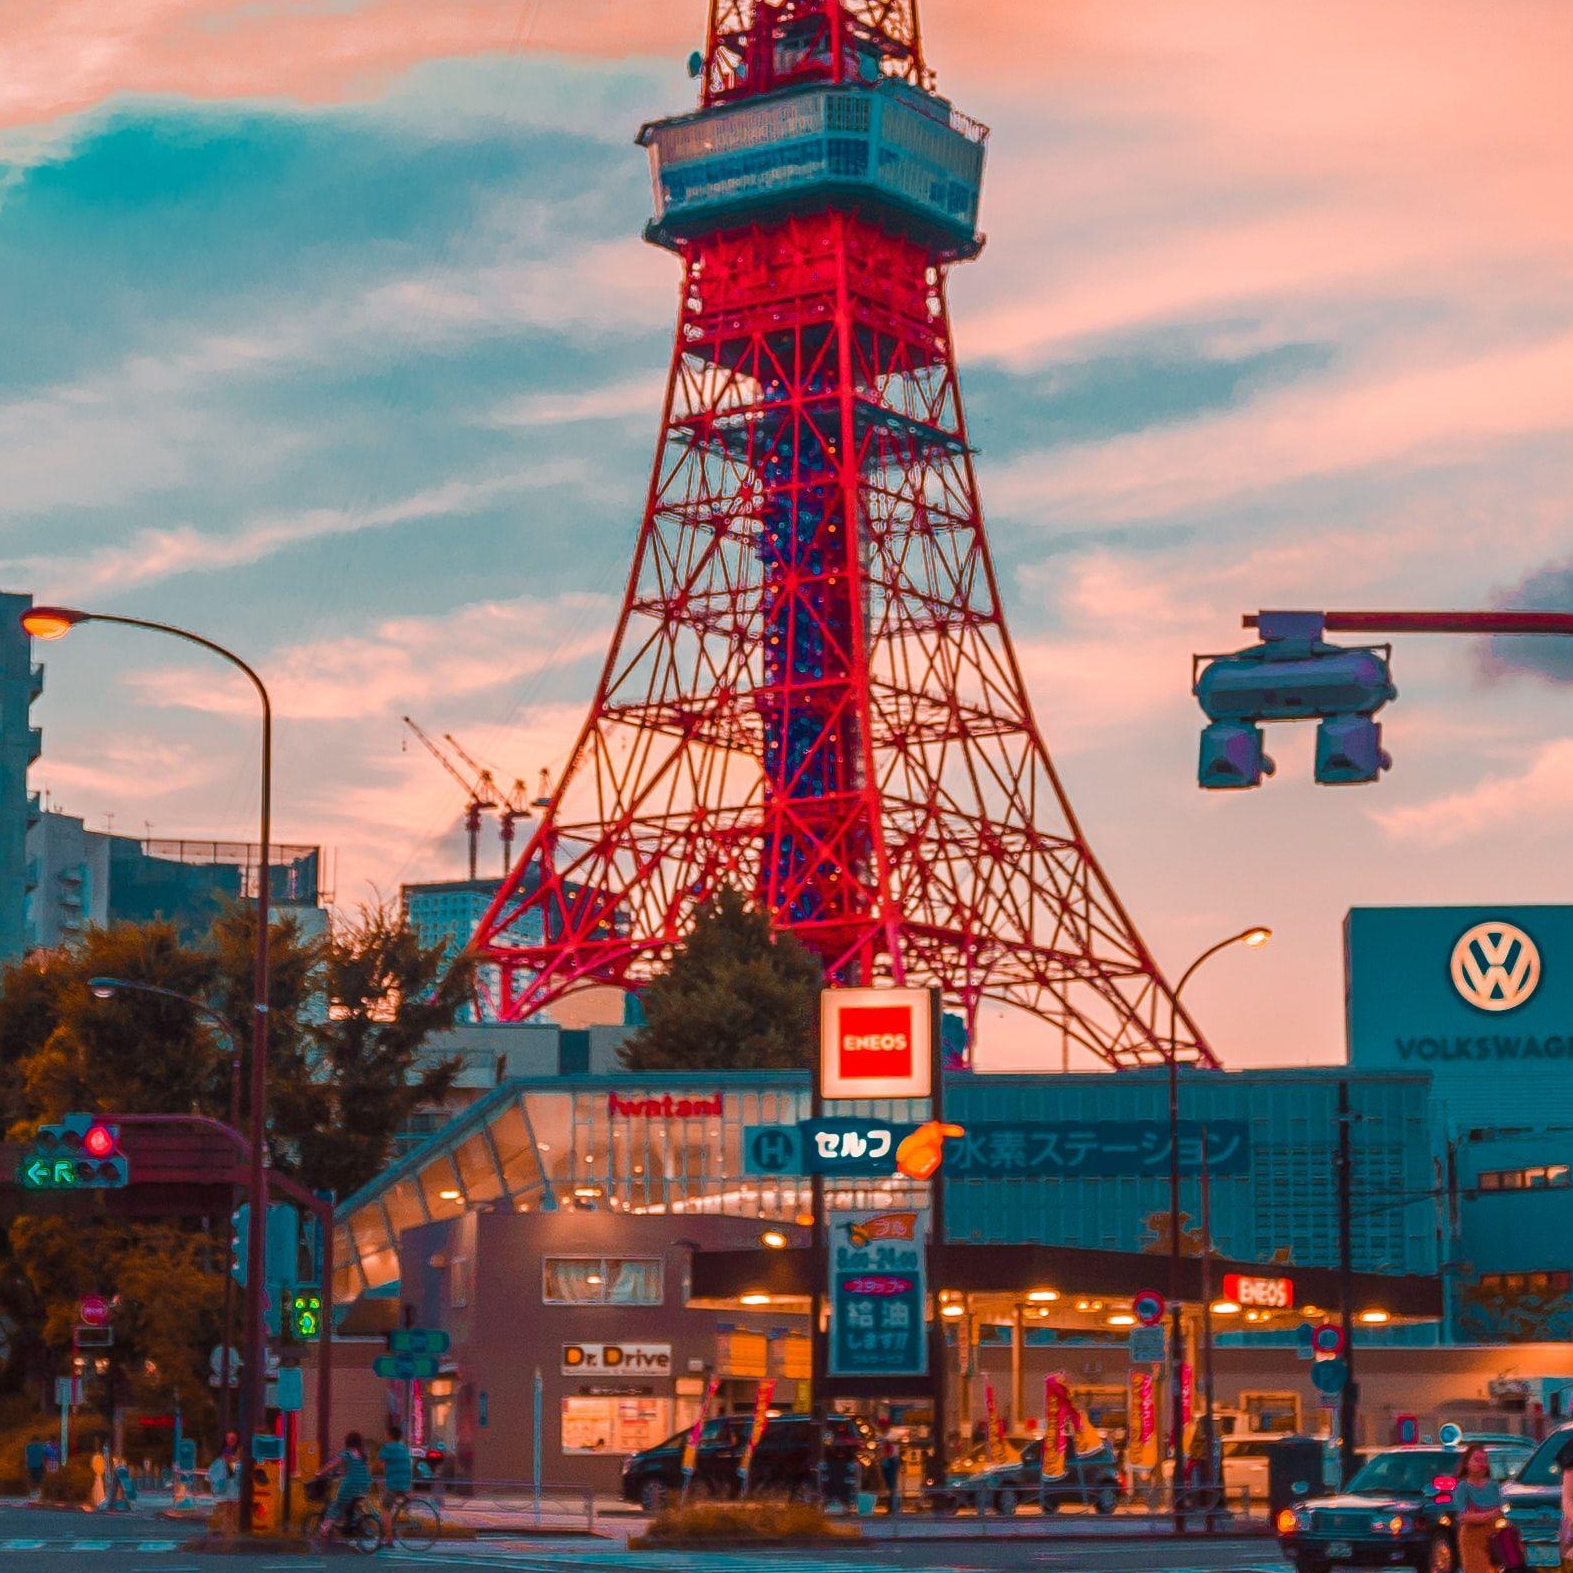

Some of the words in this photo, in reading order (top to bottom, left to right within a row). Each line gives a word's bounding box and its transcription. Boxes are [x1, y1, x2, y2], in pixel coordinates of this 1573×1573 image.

[843, 1033, 907, 1051] ENEOS
[815, 1130, 892, 1159] セルフ
[948, 1131, 1240, 1169] 水素ステーション
[1239, 1278, 1287, 1308] ENEOS
[564, 1346, 598, 1367] Dr.
[603, 1346, 670, 1368] Drive
